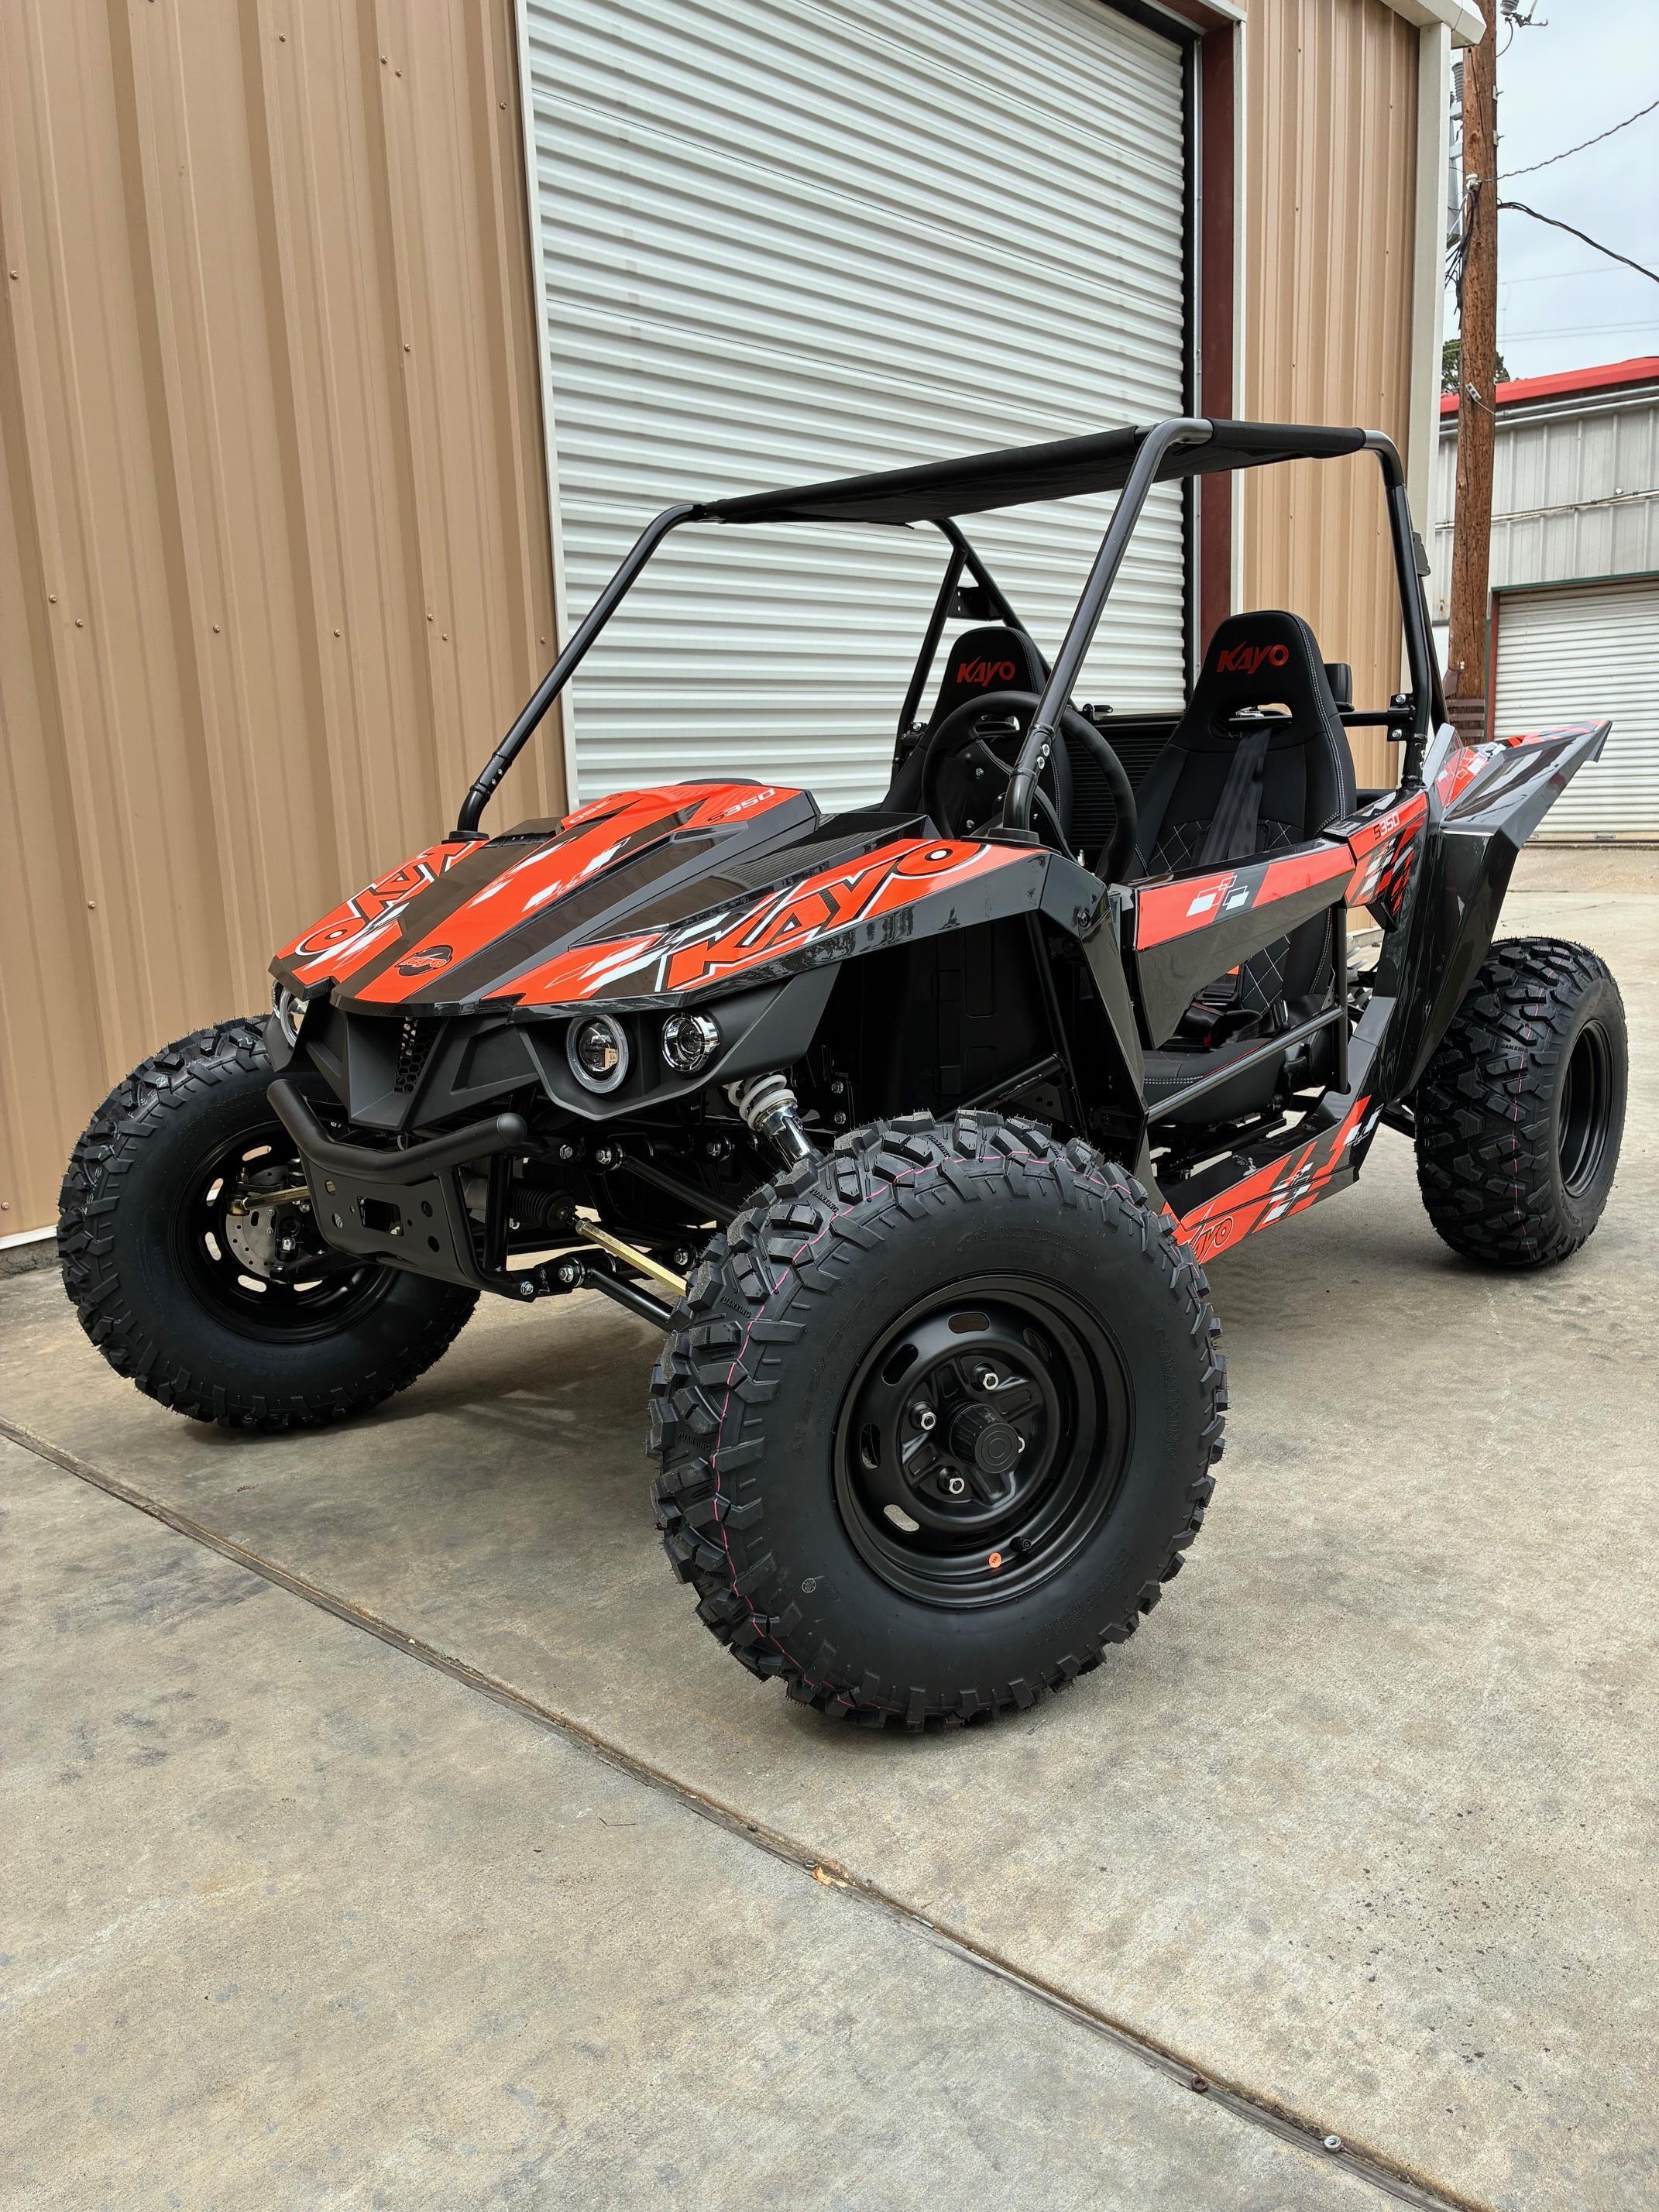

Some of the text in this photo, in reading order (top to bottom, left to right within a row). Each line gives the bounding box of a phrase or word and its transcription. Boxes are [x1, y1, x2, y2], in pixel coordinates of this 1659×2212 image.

[957, 656, 1015, 686] KAYO
[1217, 640, 1290, 674] KAYO
[707, 788, 775, 824] S350
[1372, 811, 1400, 840] S350
[661, 841, 987, 991] KAYO
[810, 1188, 840, 1214] YUANXING
[720, 1294, 752, 1318] YUANXING
